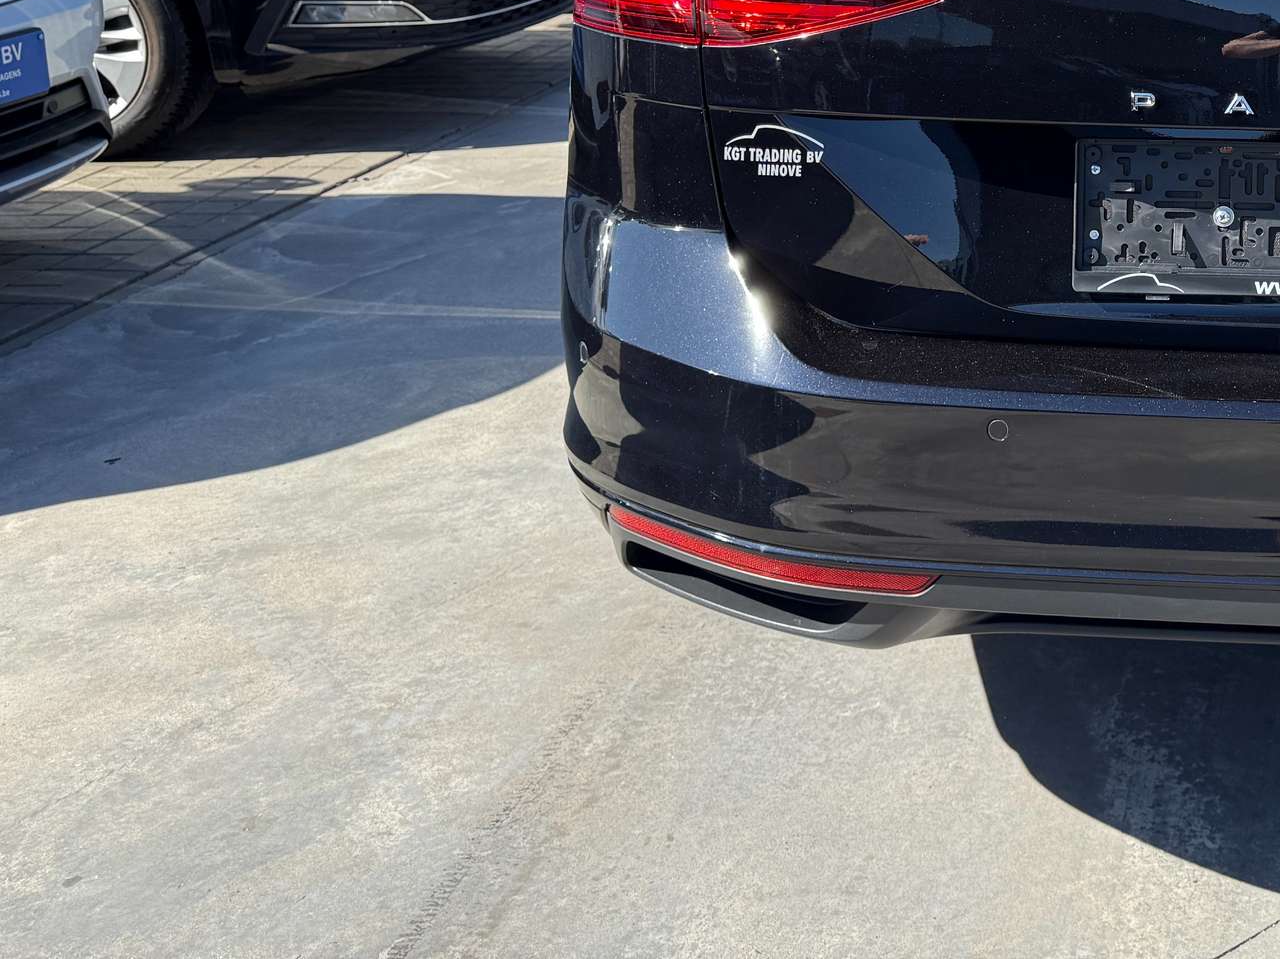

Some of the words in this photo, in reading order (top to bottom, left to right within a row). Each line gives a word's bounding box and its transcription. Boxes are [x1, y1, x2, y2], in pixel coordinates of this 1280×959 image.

[1, 42, 22, 65] BV
[724, 146, 746, 161] KGT
[749, 148, 802, 163] TRADING
[806, 151, 824, 163] BV
[758, 164, 802, 177] NINOVE
